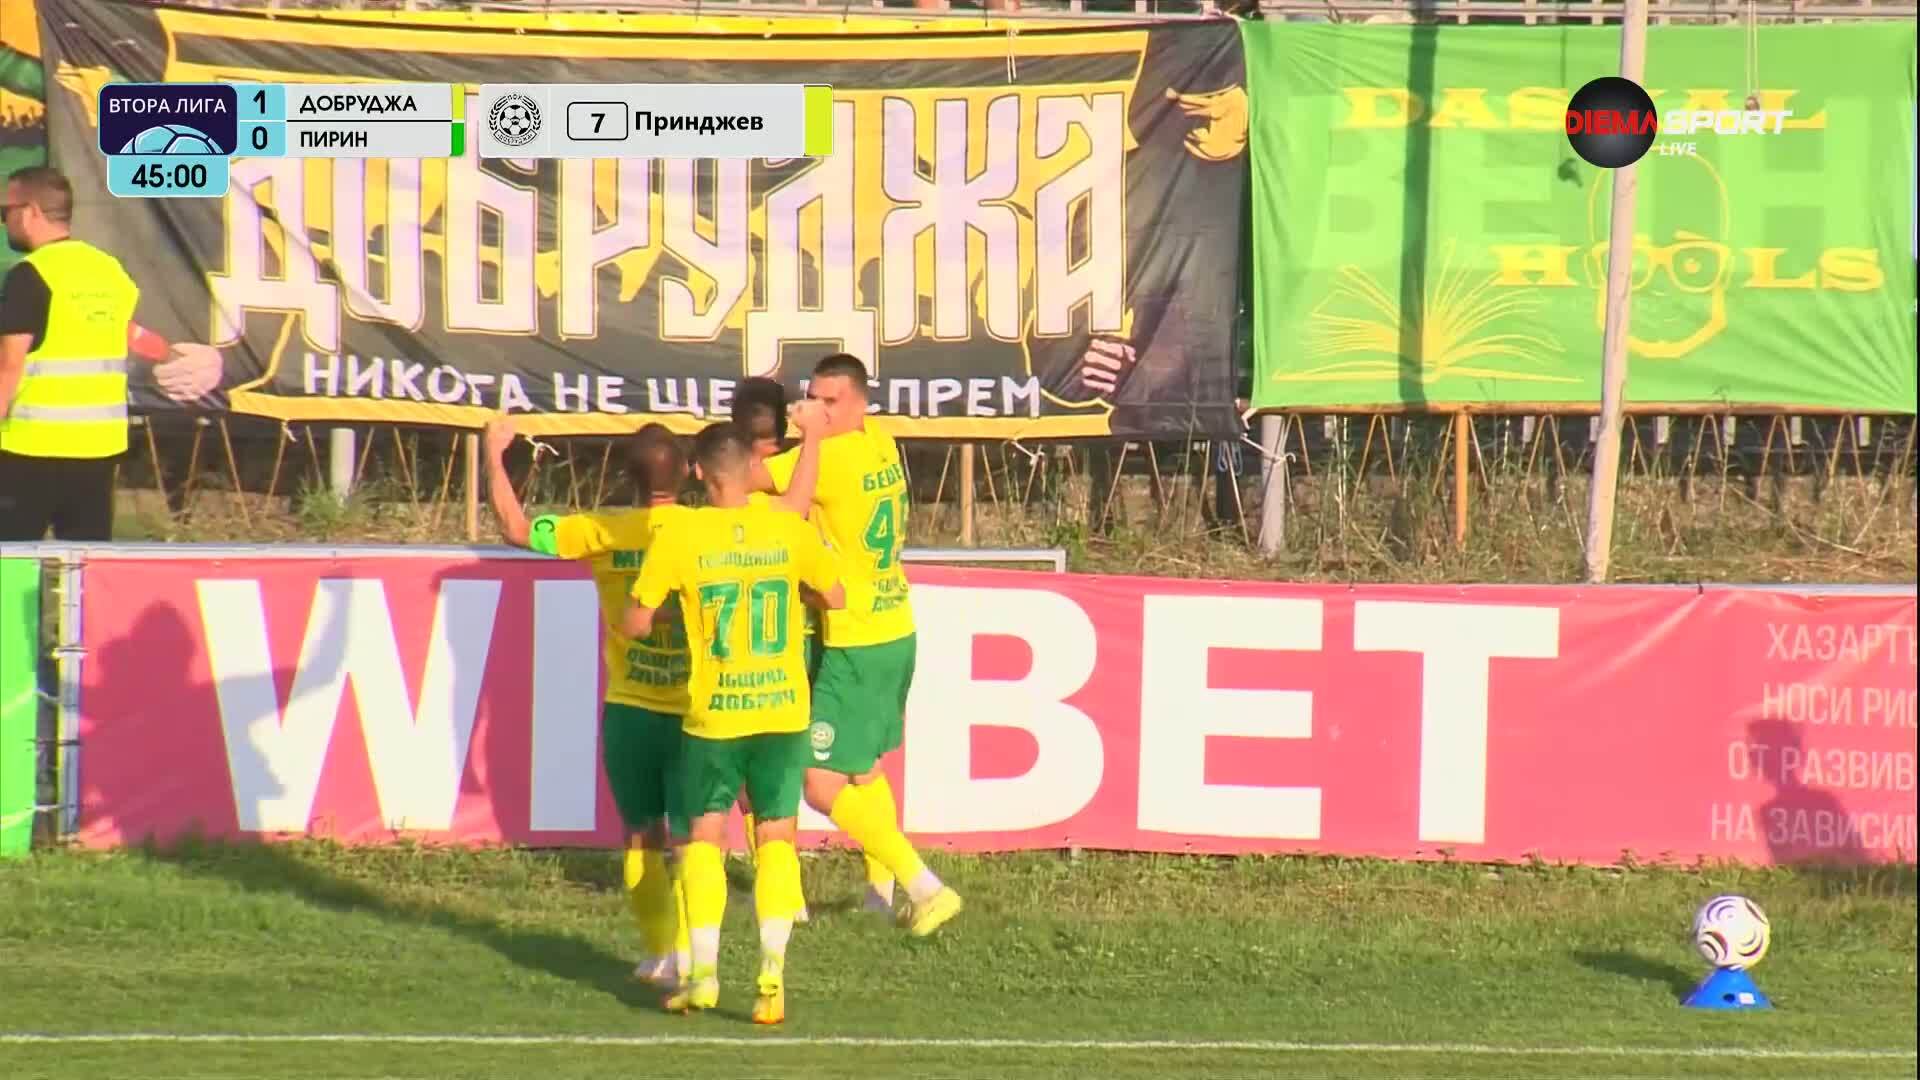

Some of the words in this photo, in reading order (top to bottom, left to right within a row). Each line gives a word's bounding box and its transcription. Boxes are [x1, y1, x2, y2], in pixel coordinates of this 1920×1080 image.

[302, 352, 534, 416] НИКОГА
[552, 371, 629, 414] НЕ
[698, 577, 791, 660] 70
[194, 578, 1560, 844] WIBET
[1762, 682, 1852, 726] НОСИ
[1728, 741, 1769, 781] ОТ
[1780, 747, 1915, 791] РАЗВИВ
[1710, 803, 1758, 843] НА
